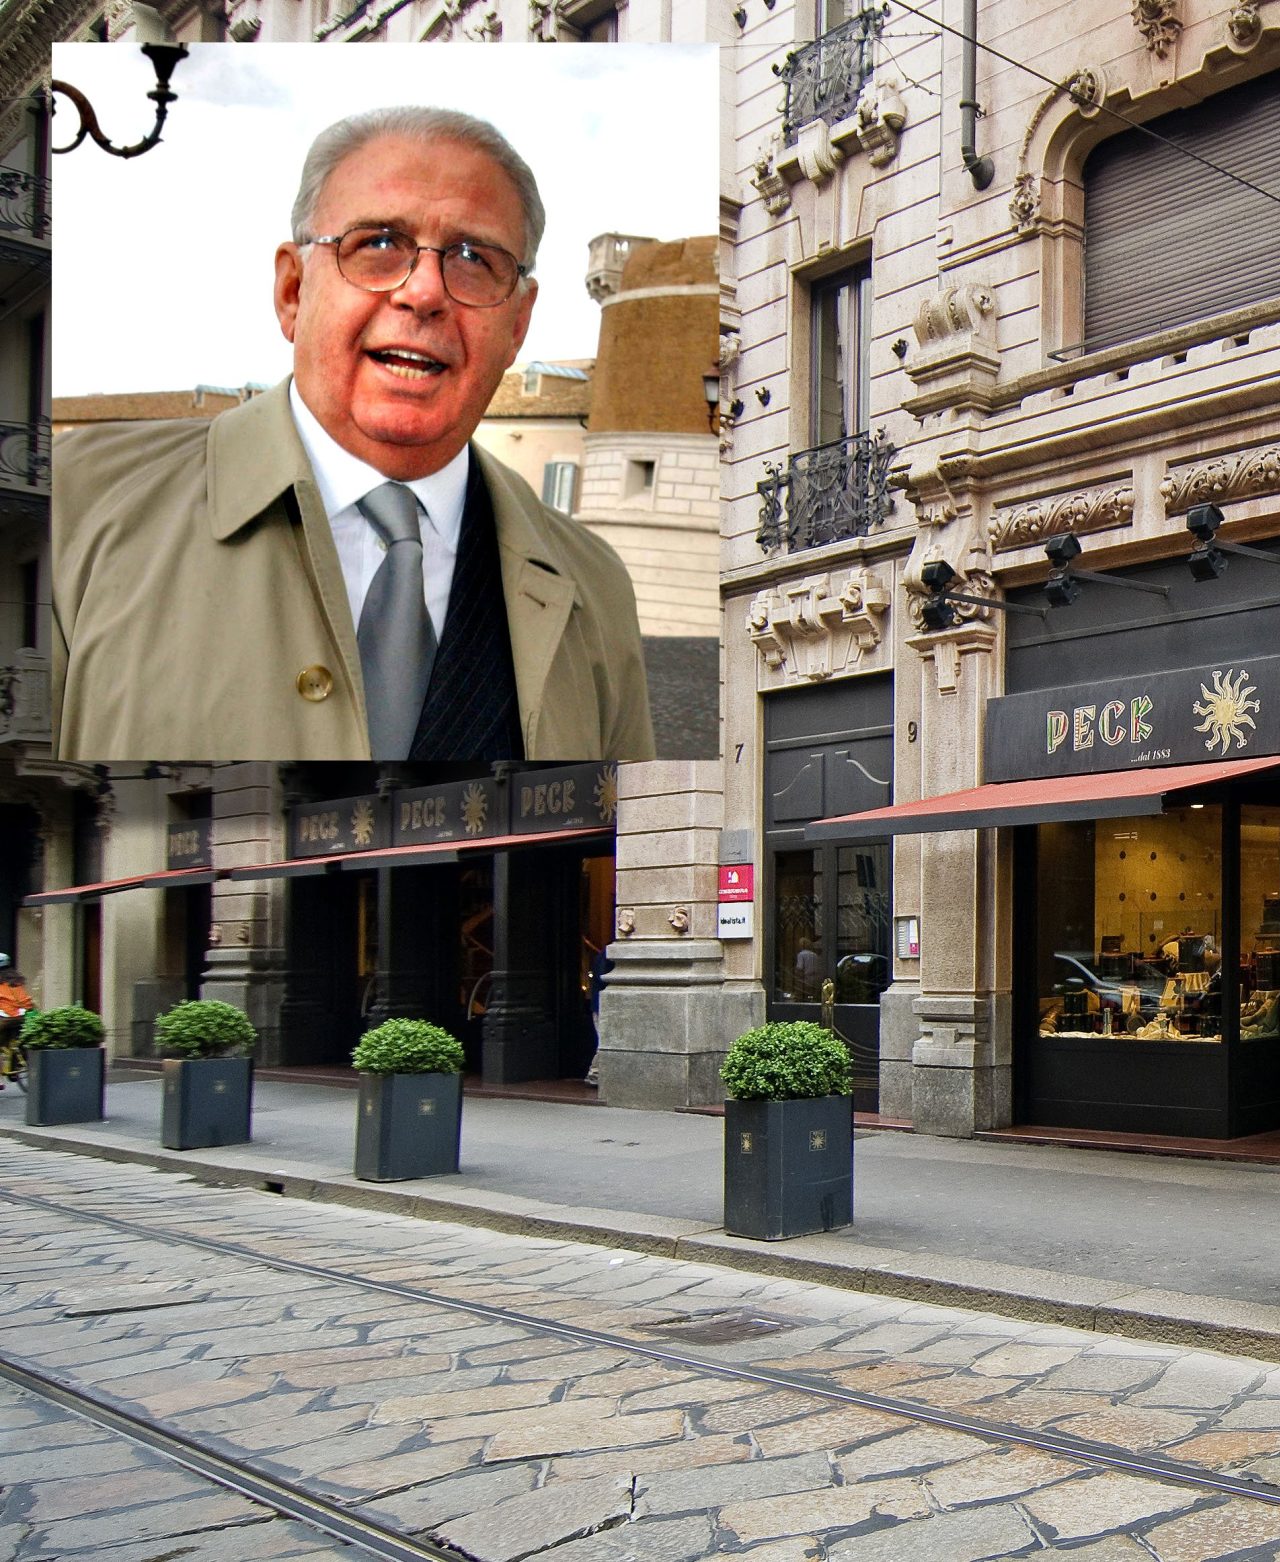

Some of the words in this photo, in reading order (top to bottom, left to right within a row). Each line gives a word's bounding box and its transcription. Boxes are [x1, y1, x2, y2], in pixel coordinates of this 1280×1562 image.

[907, 721, 918, 743] 9
[1046, 695, 1154, 754] PECK
[735, 743, 744, 763] 7
[1152, 748, 1171, 760] 1883
[520, 779, 576, 817] PECK
[400, 796, 446, 830] PECK
